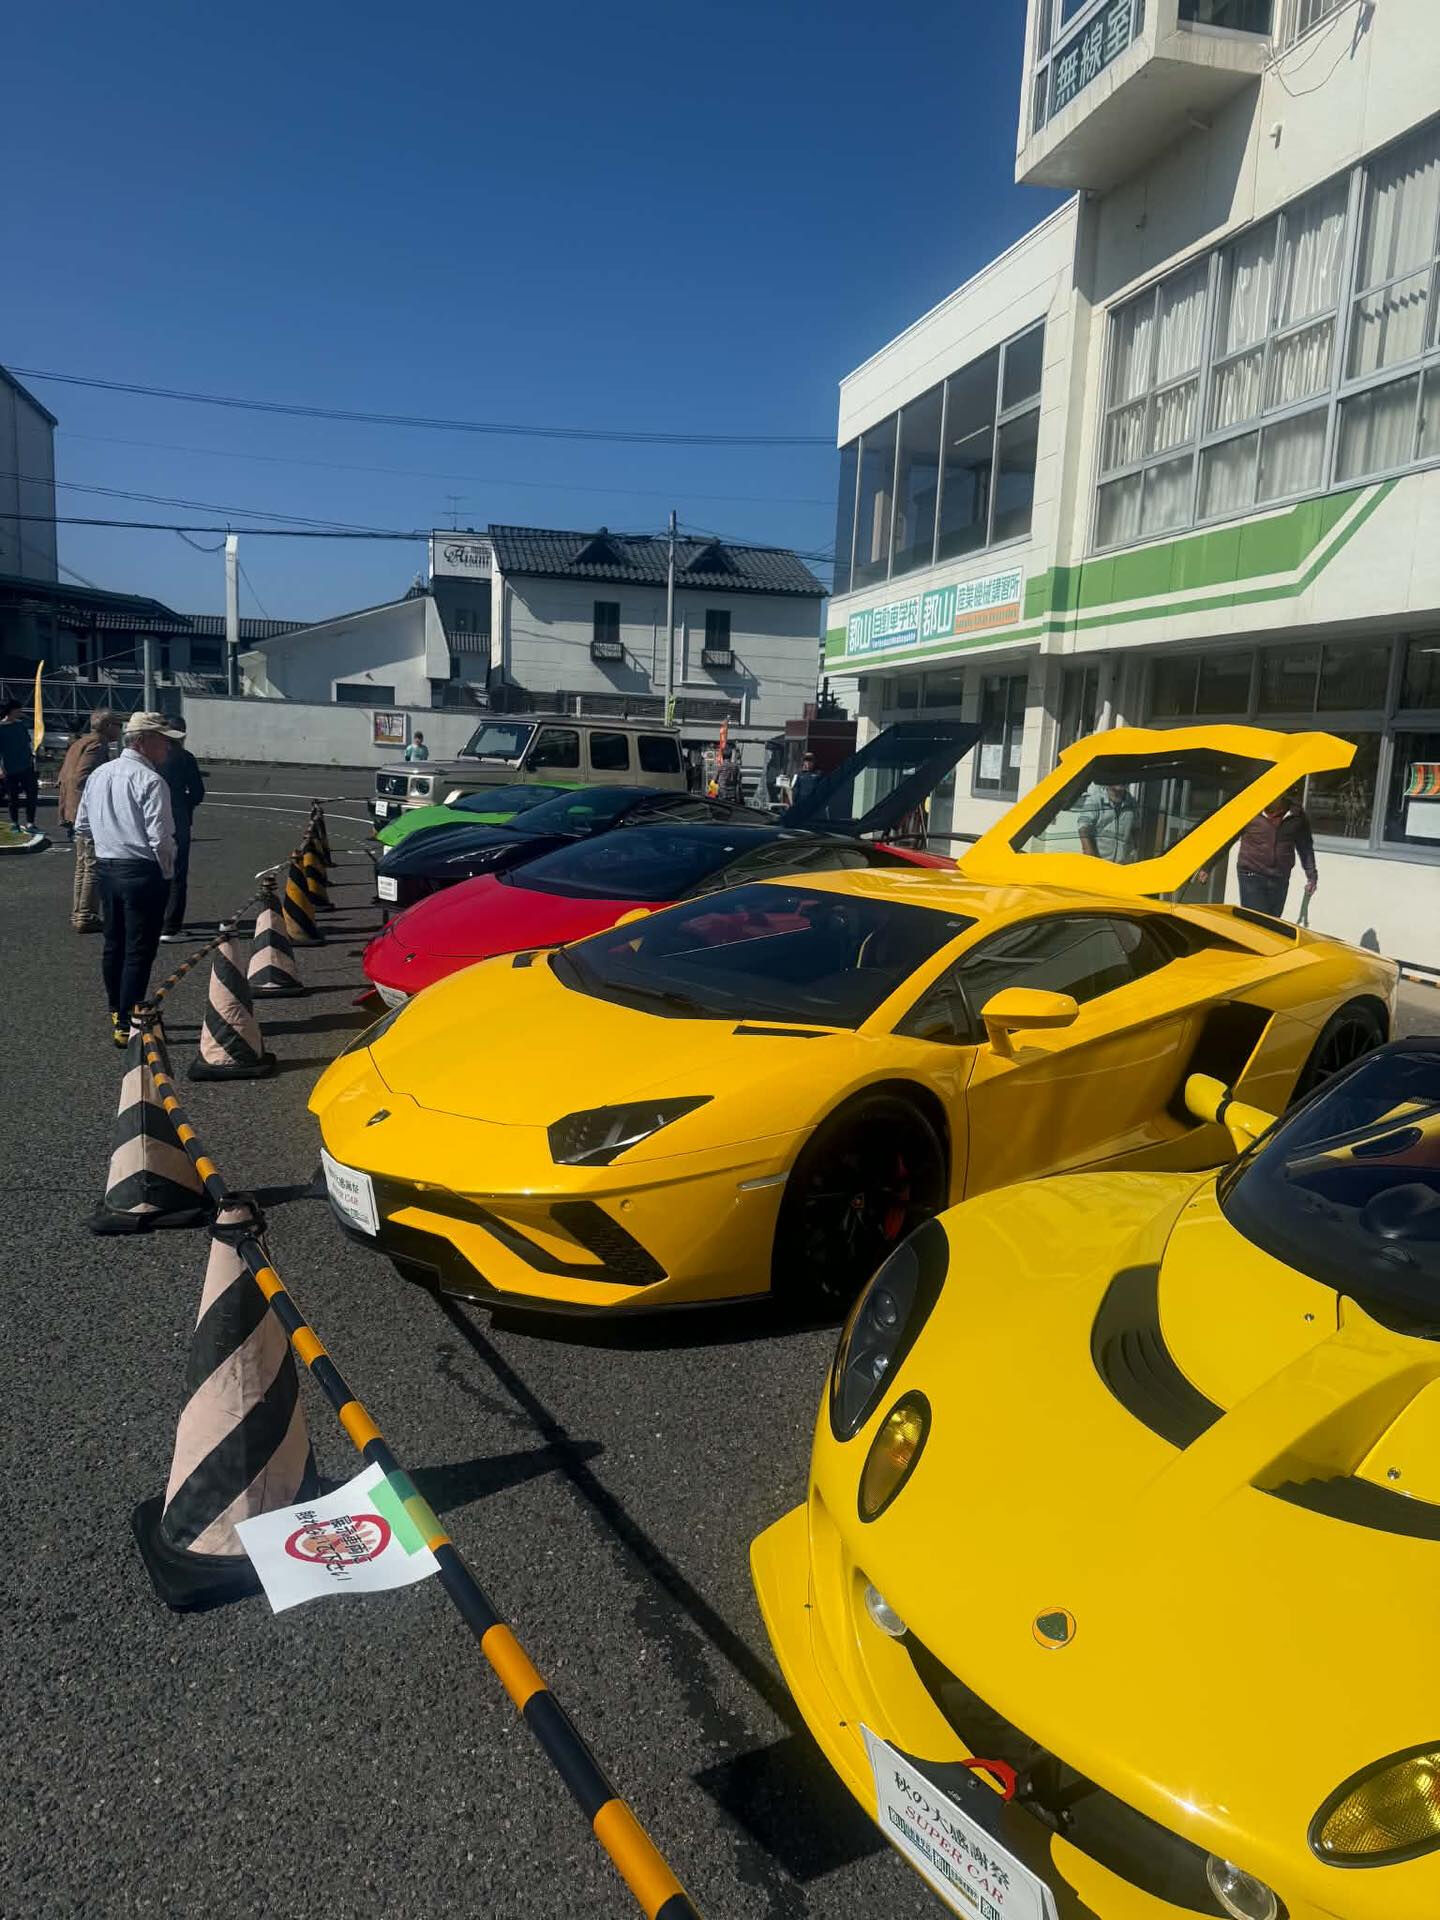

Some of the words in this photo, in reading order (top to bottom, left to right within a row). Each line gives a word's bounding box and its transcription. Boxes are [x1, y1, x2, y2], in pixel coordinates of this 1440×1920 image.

[1055, 0, 1130, 111] 無線室
[849, 614, 872, 652] 郡山
[874, 600, 919, 633] 自動車学校
[923, 591, 954, 637] 郡山
[294, 1510, 353, 1582] 触れないで下さい
[894, 1770, 1011, 1891] 秋の大感謝祭
[905, 1805, 964, 1864] SUPER
[966, 1862, 1005, 1906] CAR
